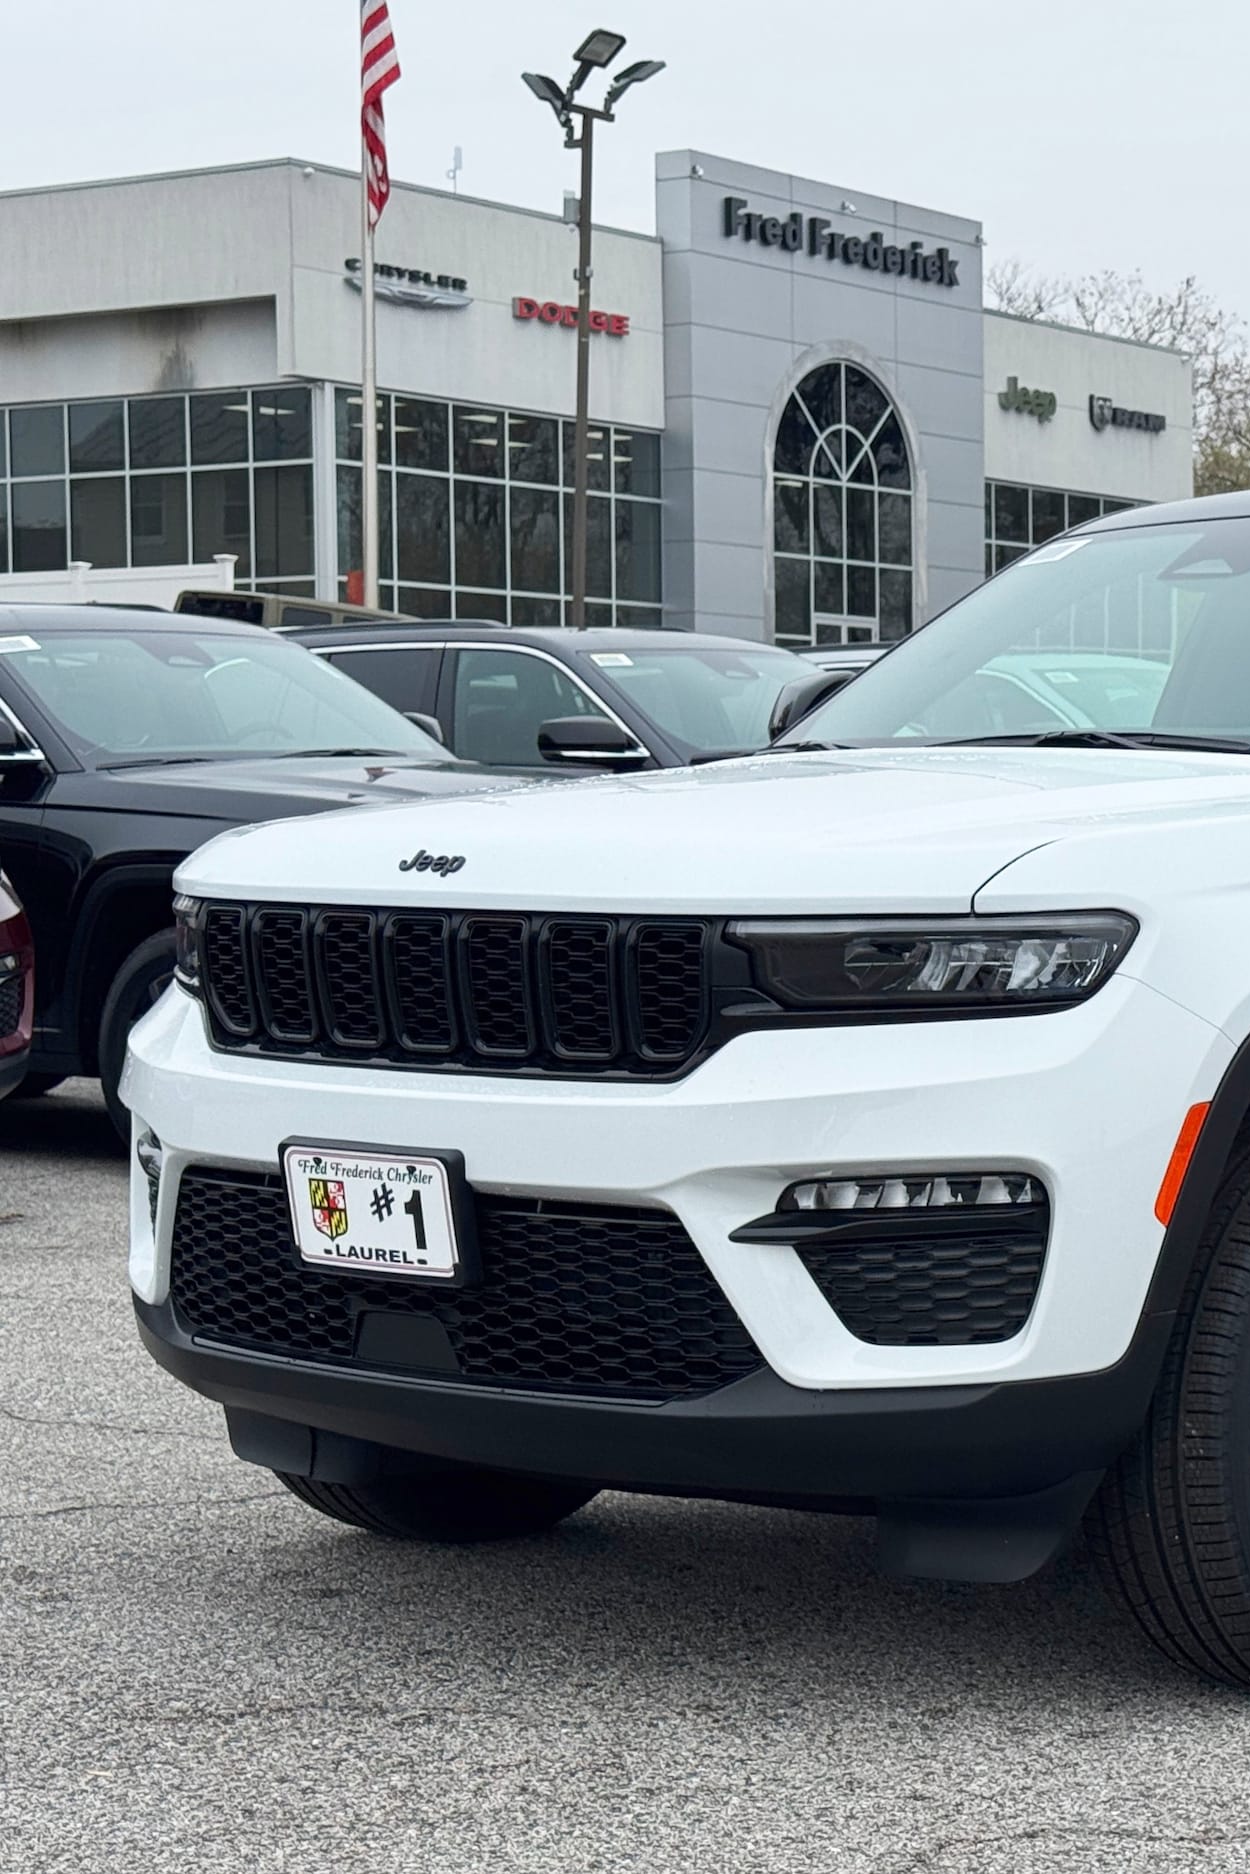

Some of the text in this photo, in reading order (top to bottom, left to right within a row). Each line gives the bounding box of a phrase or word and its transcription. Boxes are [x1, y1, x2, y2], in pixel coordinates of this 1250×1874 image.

[724, 197, 959, 287] Fred Frederick
[344, 257, 468, 291] CRYSLER
[998, 376, 1056, 423] Jeep
[1112, 407, 1166, 434] RAM
[399, 849, 466, 877] Jeep
[298, 1159, 433, 1185] Fred Frederick Chrysler
